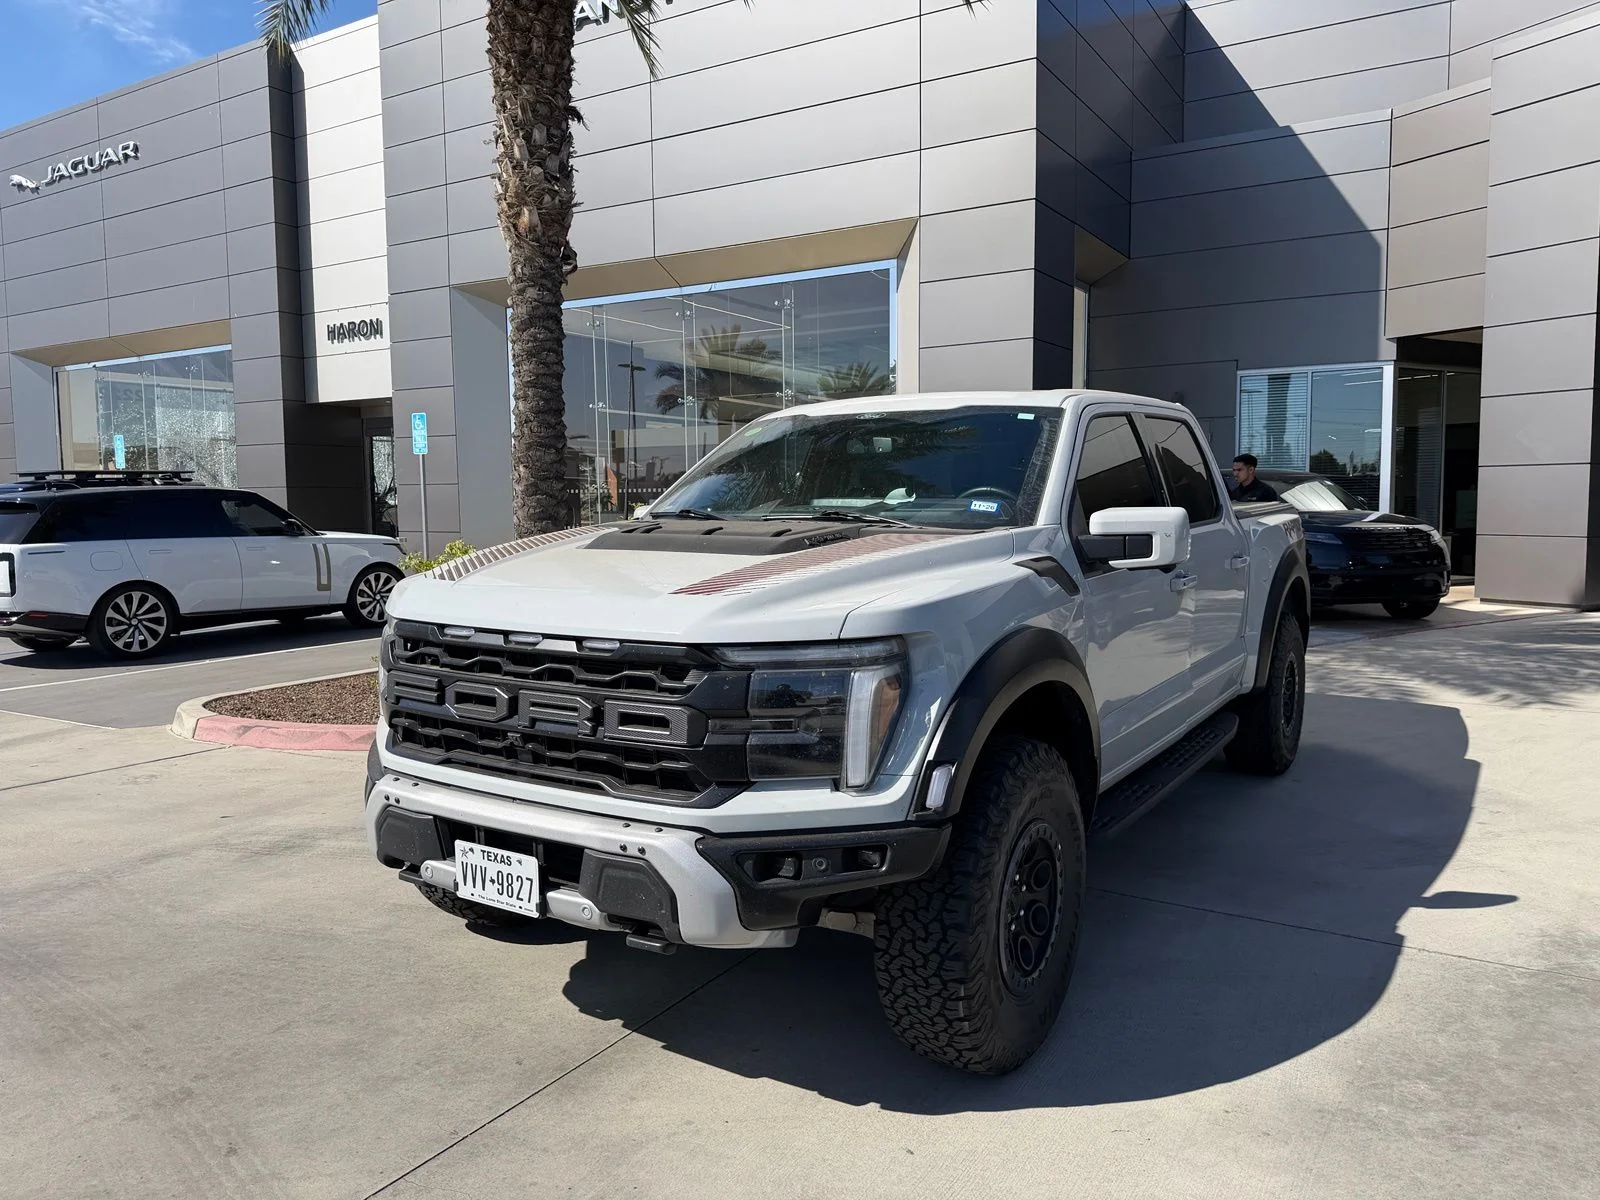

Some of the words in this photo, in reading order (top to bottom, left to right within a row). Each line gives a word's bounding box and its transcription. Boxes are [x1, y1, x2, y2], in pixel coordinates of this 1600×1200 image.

[41, 140, 139, 187] JAGUAR
[327, 318, 383, 343] HARON
[386, 669, 706, 748] FORD
[480, 849, 512, 867] TEXAS
